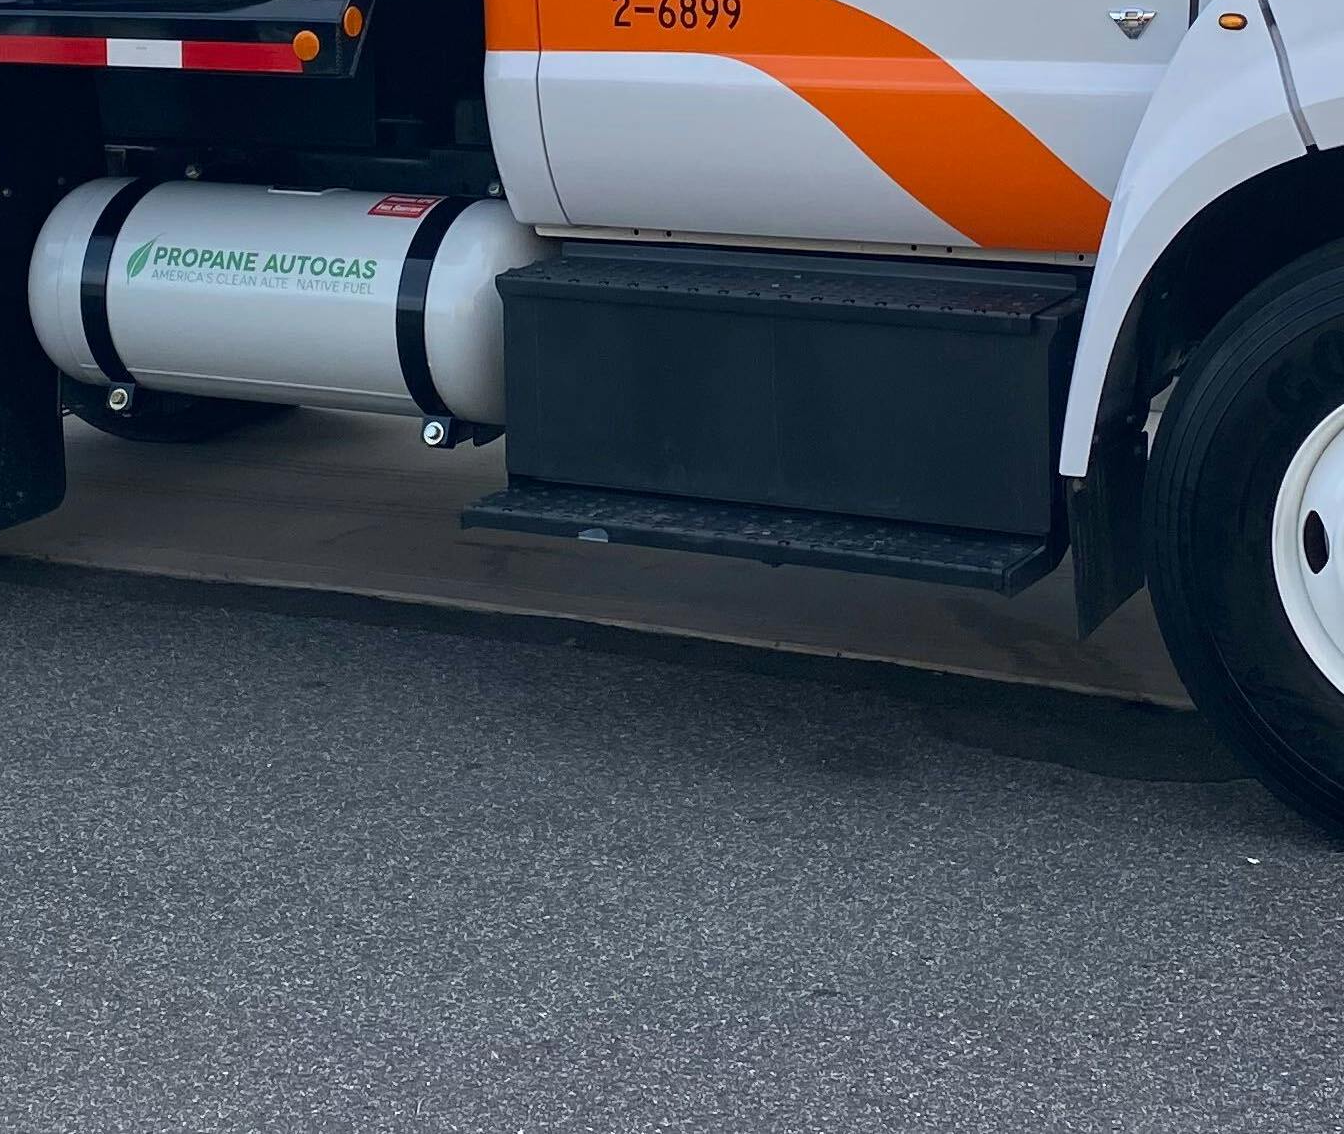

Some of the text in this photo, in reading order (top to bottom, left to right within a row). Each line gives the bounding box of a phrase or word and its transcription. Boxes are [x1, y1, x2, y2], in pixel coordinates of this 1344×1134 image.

[153, 246, 378, 280] PROPANE AUTOGAS
[216, 275, 256, 287] CLEAN
[343, 282, 375, 295] FUEL
